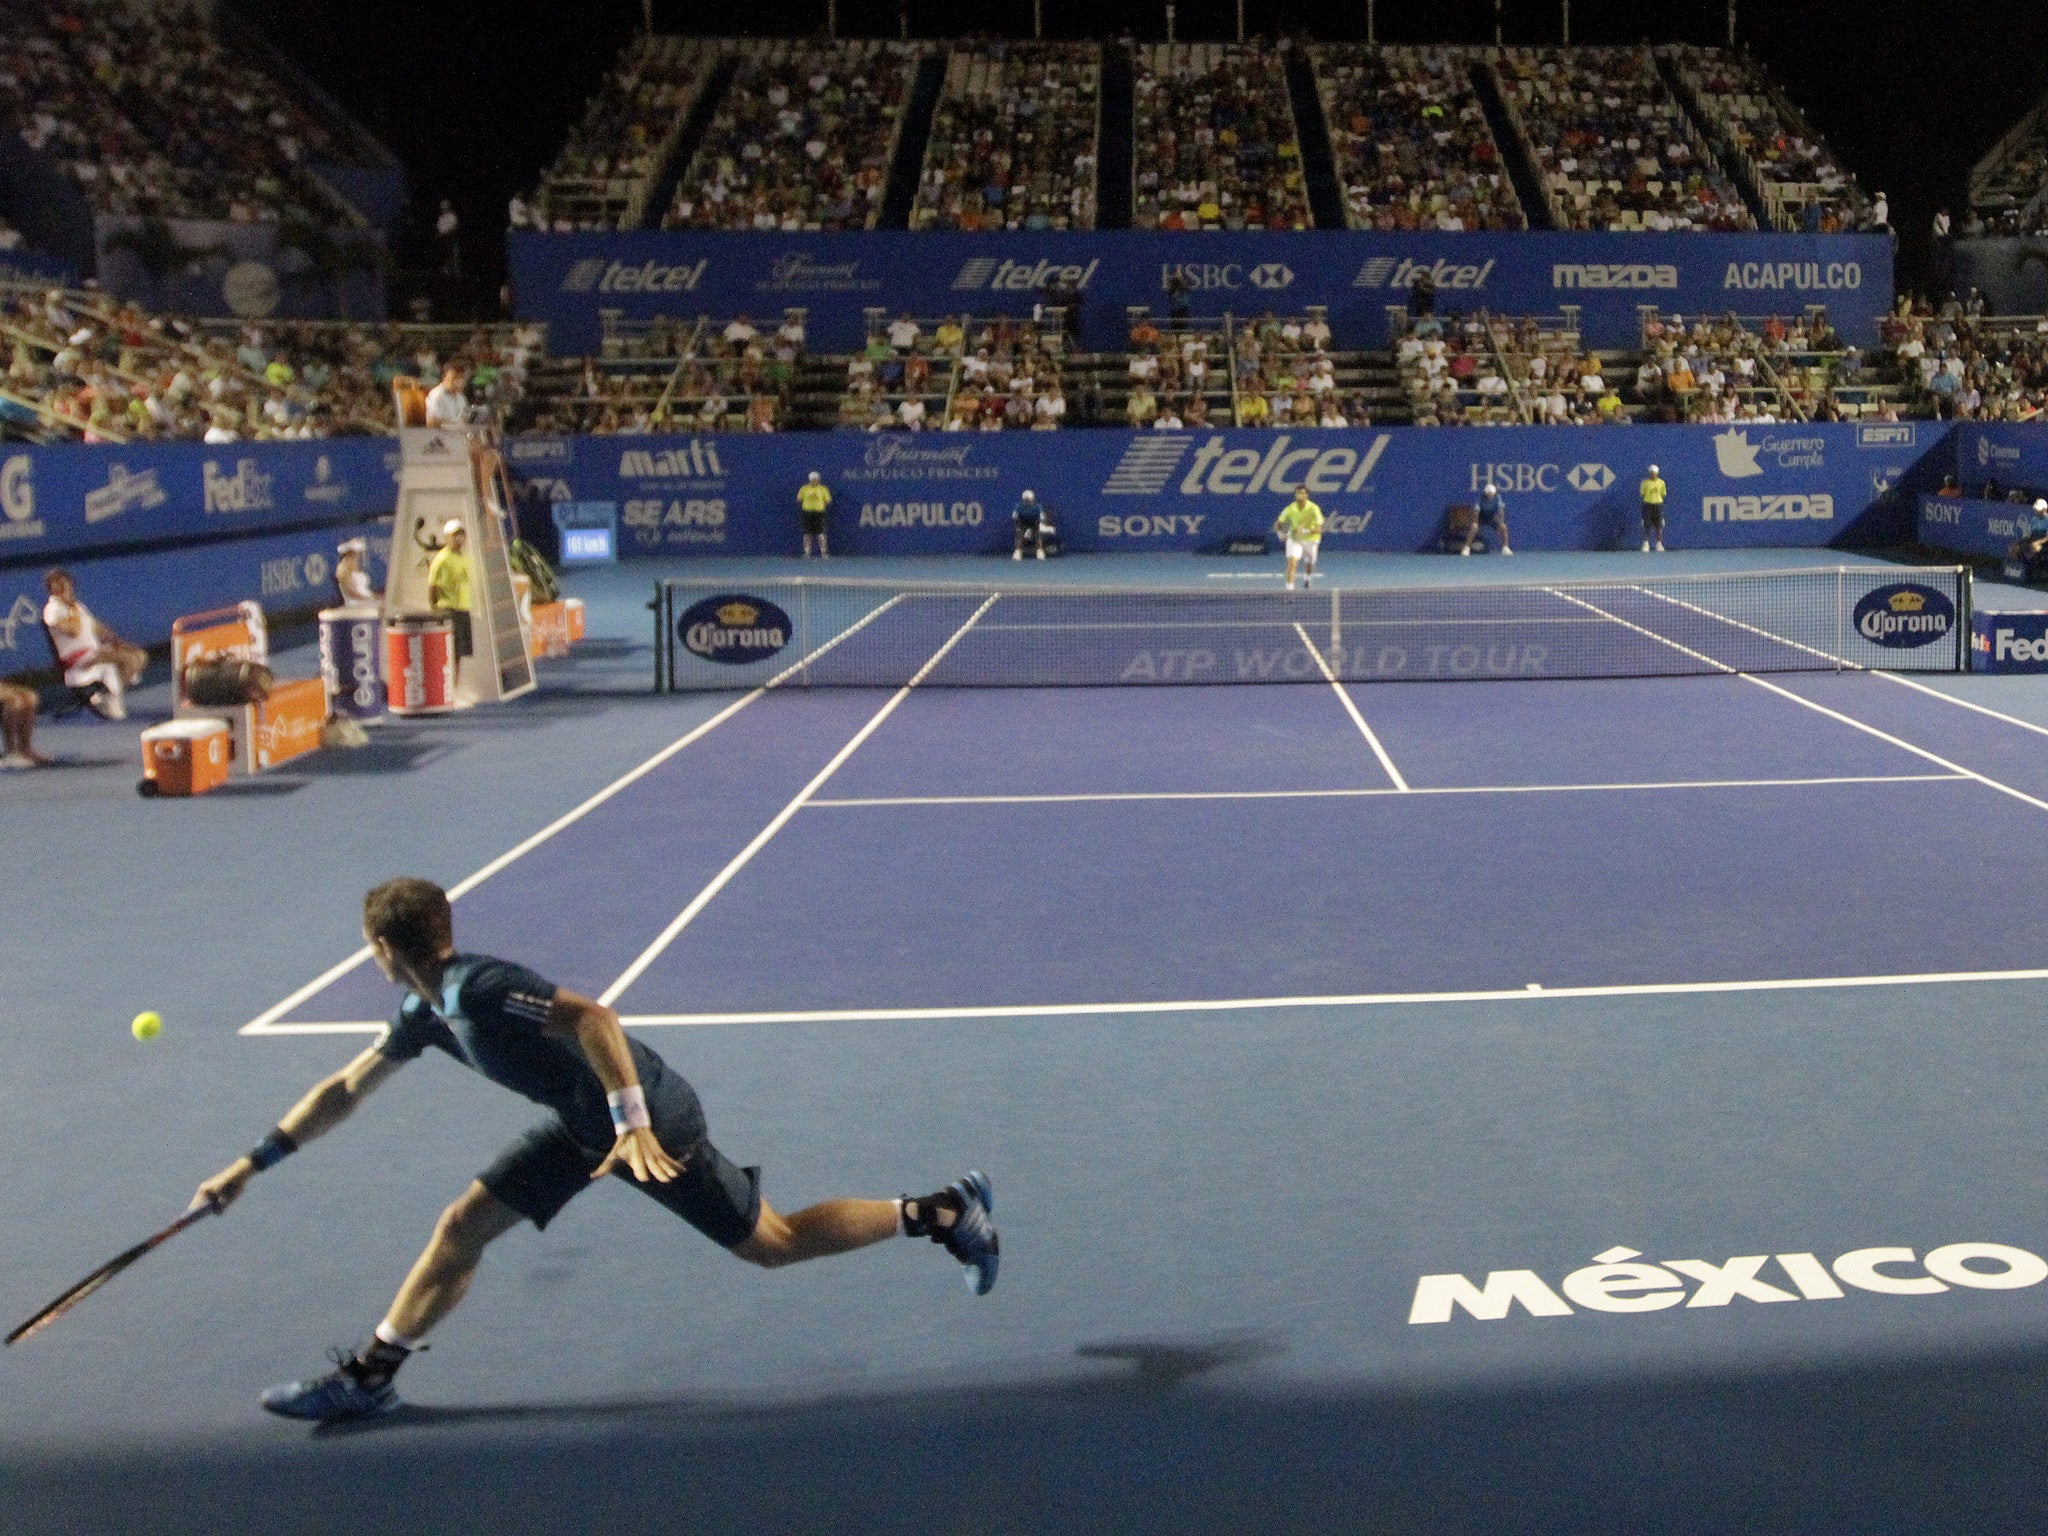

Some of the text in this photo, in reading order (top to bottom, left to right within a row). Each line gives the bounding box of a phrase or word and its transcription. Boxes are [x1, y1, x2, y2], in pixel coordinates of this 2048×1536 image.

[597, 259, 705, 291] telcel
[990, 258, 1099, 290] telcel
[1159, 263, 1240, 289] HSBC
[1391, 258, 1494, 289] telcel
[1724, 262, 1862, 290] ACAPULCO
[1863, 428, 1909, 442] ESPN
[1180, 434, 1391, 494] telcel
[1470, 463, 1560, 492] HSBC
[203, 459, 274, 514] FedEx
[623, 500, 726, 525] SEARS
[857, 501, 981, 528] ACAPULCO
[1098, 515, 1205, 536] SONY
[1925, 502, 1962, 524] SONY
[686, 623, 783, 654] Corona
[1861, 610, 1948, 639] Corona
